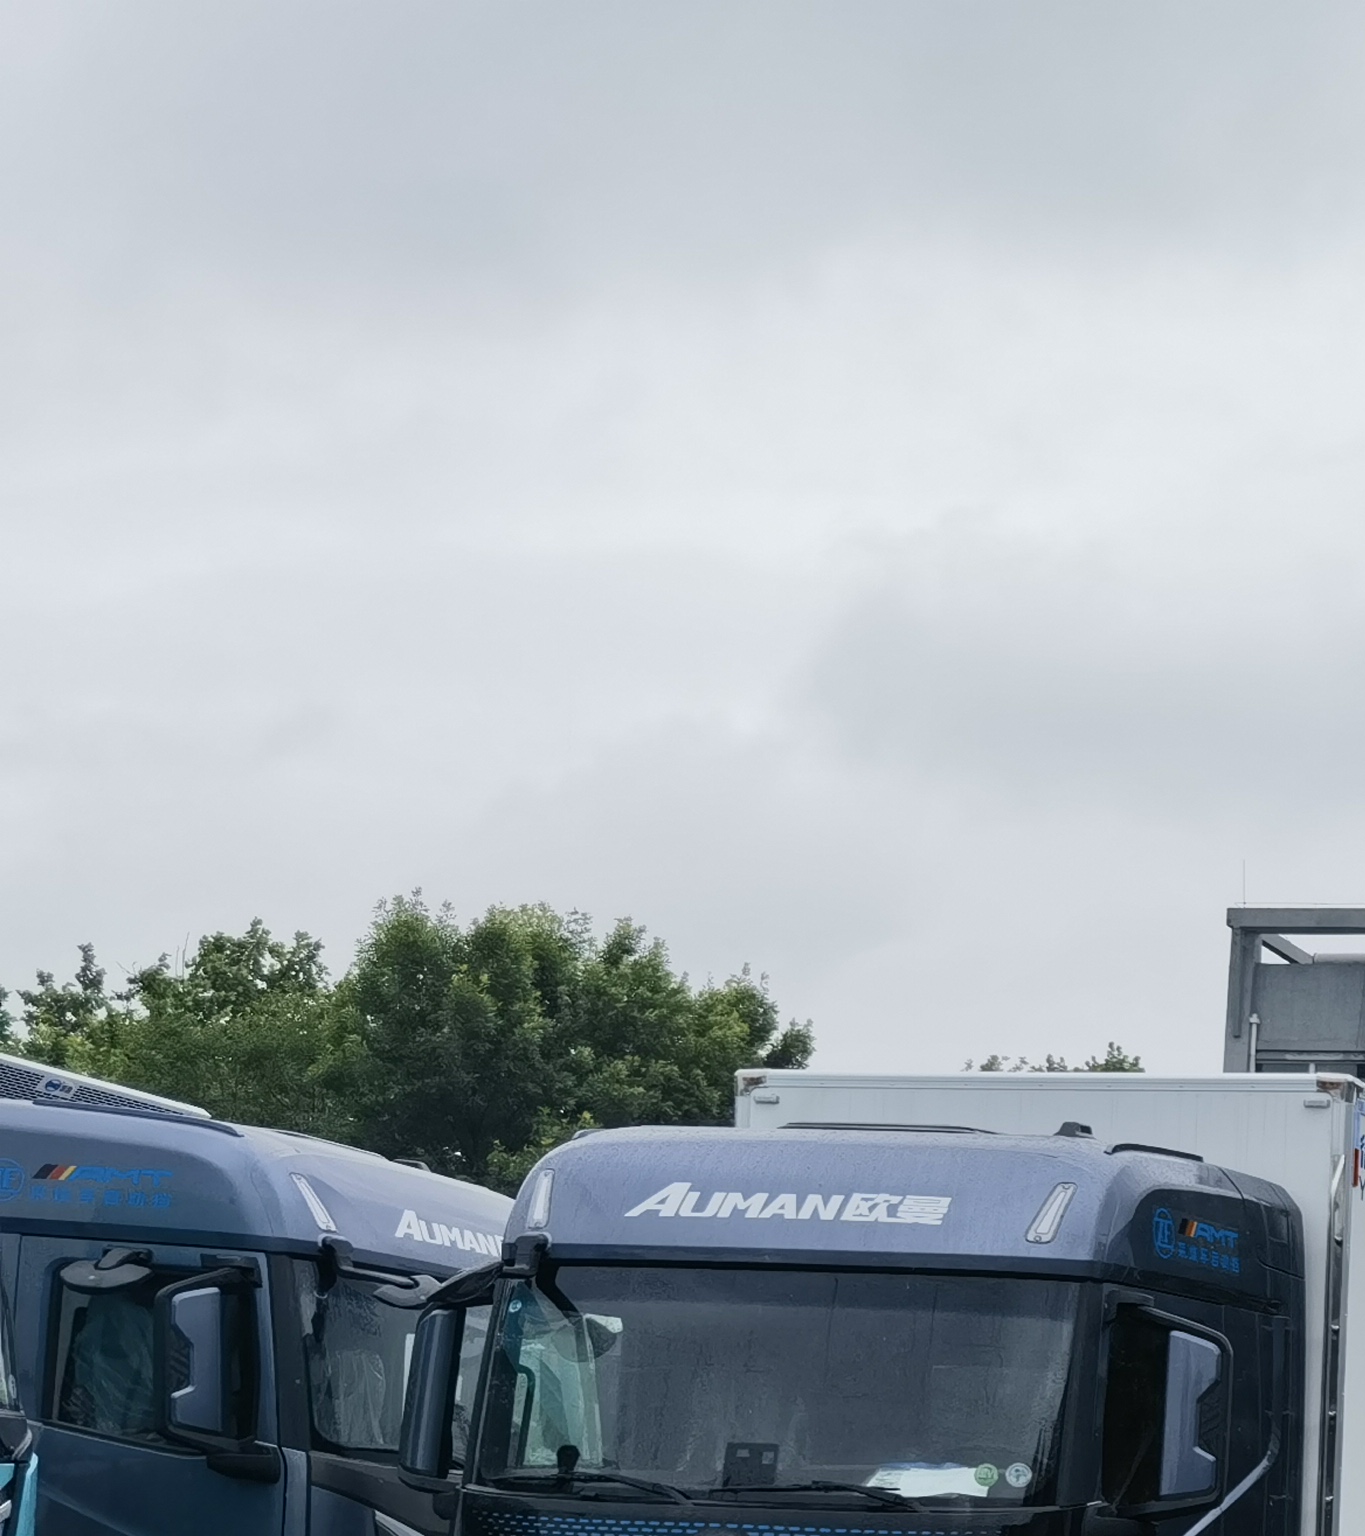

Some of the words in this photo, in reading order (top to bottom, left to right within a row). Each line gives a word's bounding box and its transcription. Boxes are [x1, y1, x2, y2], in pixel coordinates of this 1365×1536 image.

[68, 1165, 174, 1188] AMT
[623, 1181, 953, 1226] AUMAN欧曼
[394, 1208, 504, 1258] AUMAN
[1195, 1222, 1239, 1249] AMT
